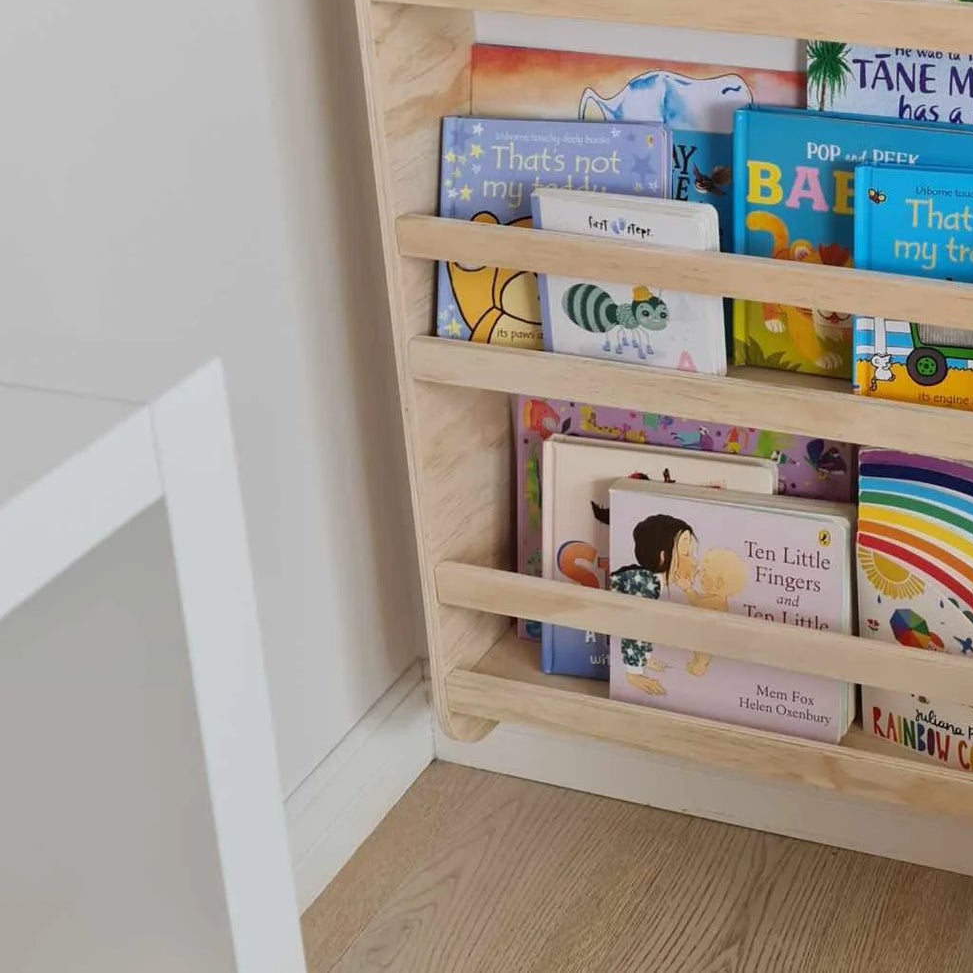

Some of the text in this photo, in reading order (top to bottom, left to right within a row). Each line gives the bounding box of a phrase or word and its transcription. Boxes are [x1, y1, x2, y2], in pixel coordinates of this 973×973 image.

[852, 53, 937, 94] TĀNE
[898, 94, 940, 123] has
[949, 107, 964, 125] a
[490, 141, 623, 175] That's not
[806, 141, 842, 162] POP
[482, 178, 523, 208] my
[915, 185, 954, 198] Usborne
[893, 238, 938, 271] my
[496, 328, 509, 340] its
[511, 329, 536, 342] paws
[917, 392, 932, 404] its
[744, 540, 832, 571] Ten Little
[754, 566, 822, 593] Fingers
[776, 595, 800, 608] and
[755, 682, 815, 707] Mem Fox
[738, 696, 833, 727] Helen Oxenbury
[915, 707, 965, 737] Juliana
[872, 706, 951, 763] RAINBOW
